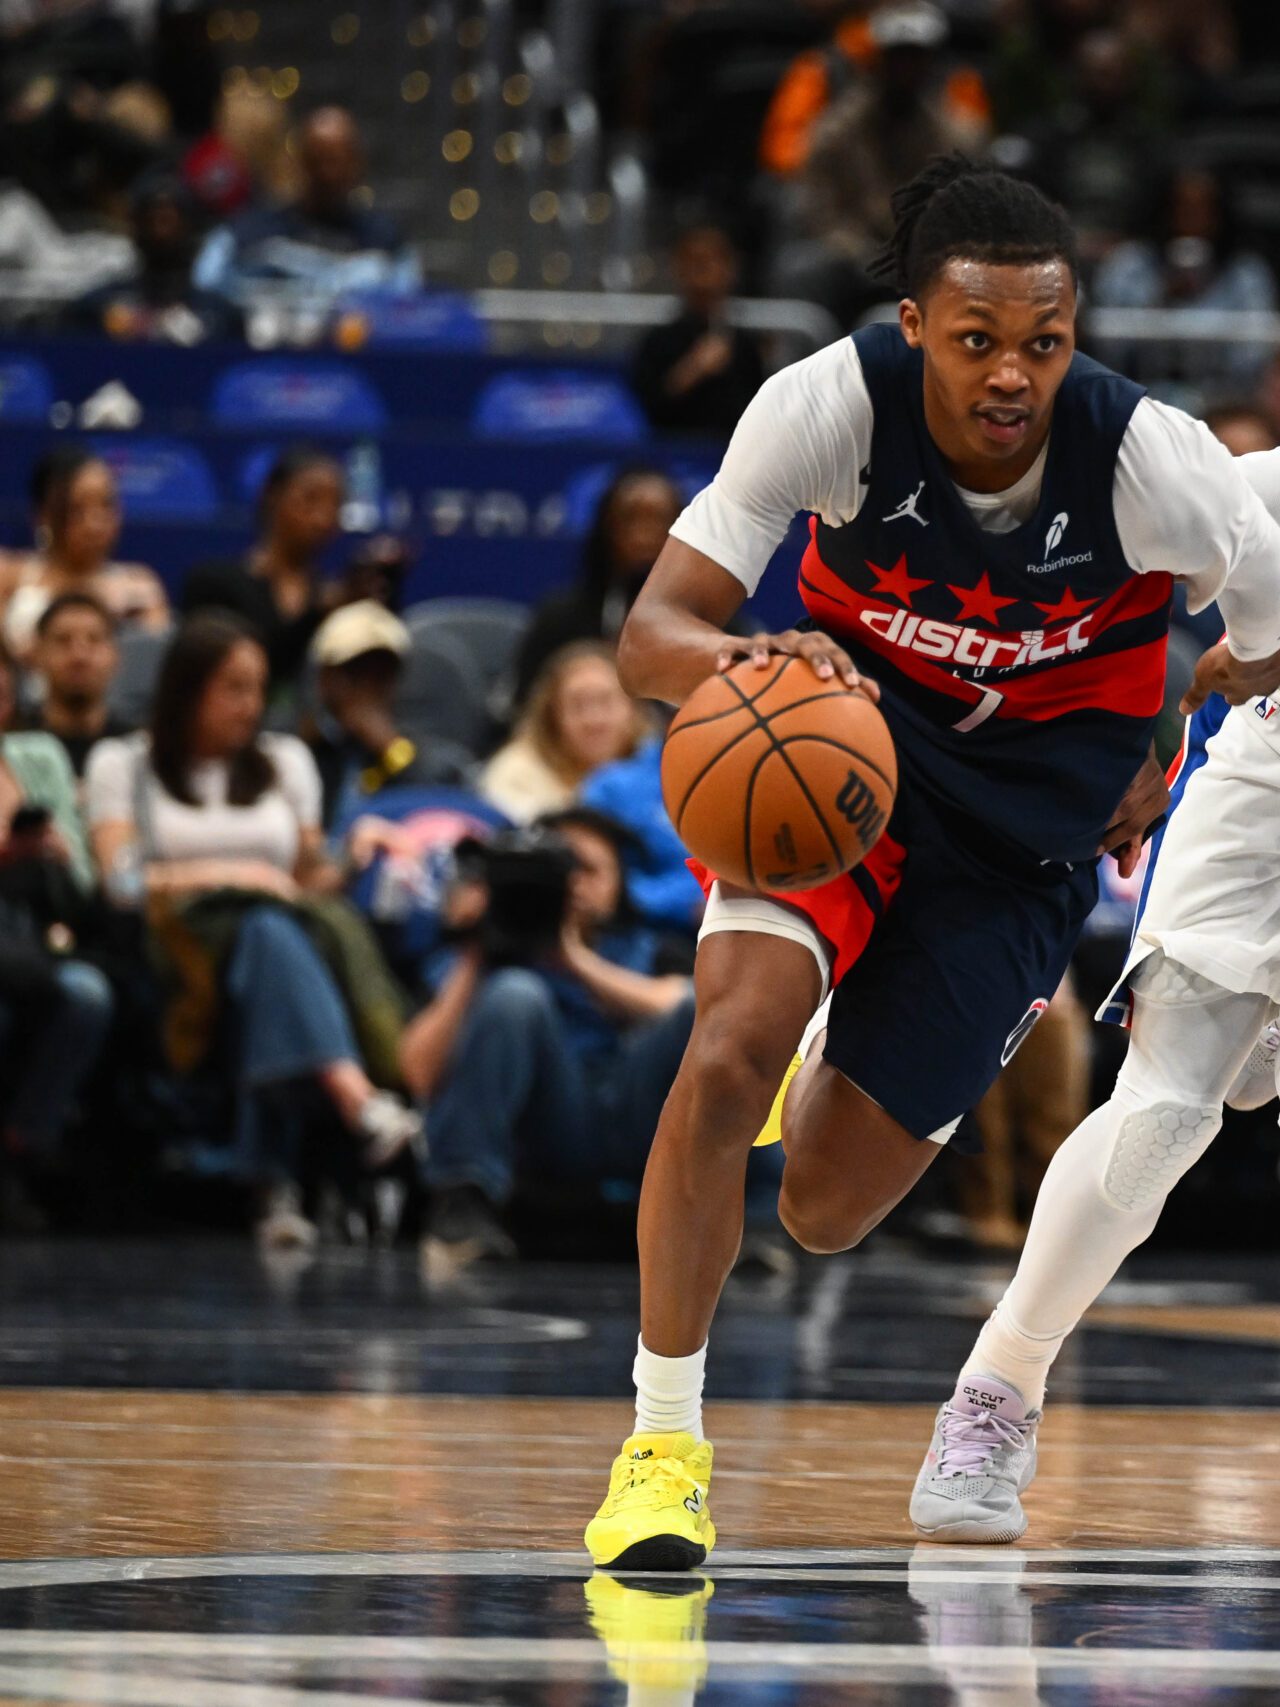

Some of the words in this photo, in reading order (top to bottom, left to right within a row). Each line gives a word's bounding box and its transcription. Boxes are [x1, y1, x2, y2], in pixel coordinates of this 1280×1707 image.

[1027, 550, 1092, 573] Robinhood
[859, 609, 1094, 667] district
[980, 1392, 1007, 1404] CUT
